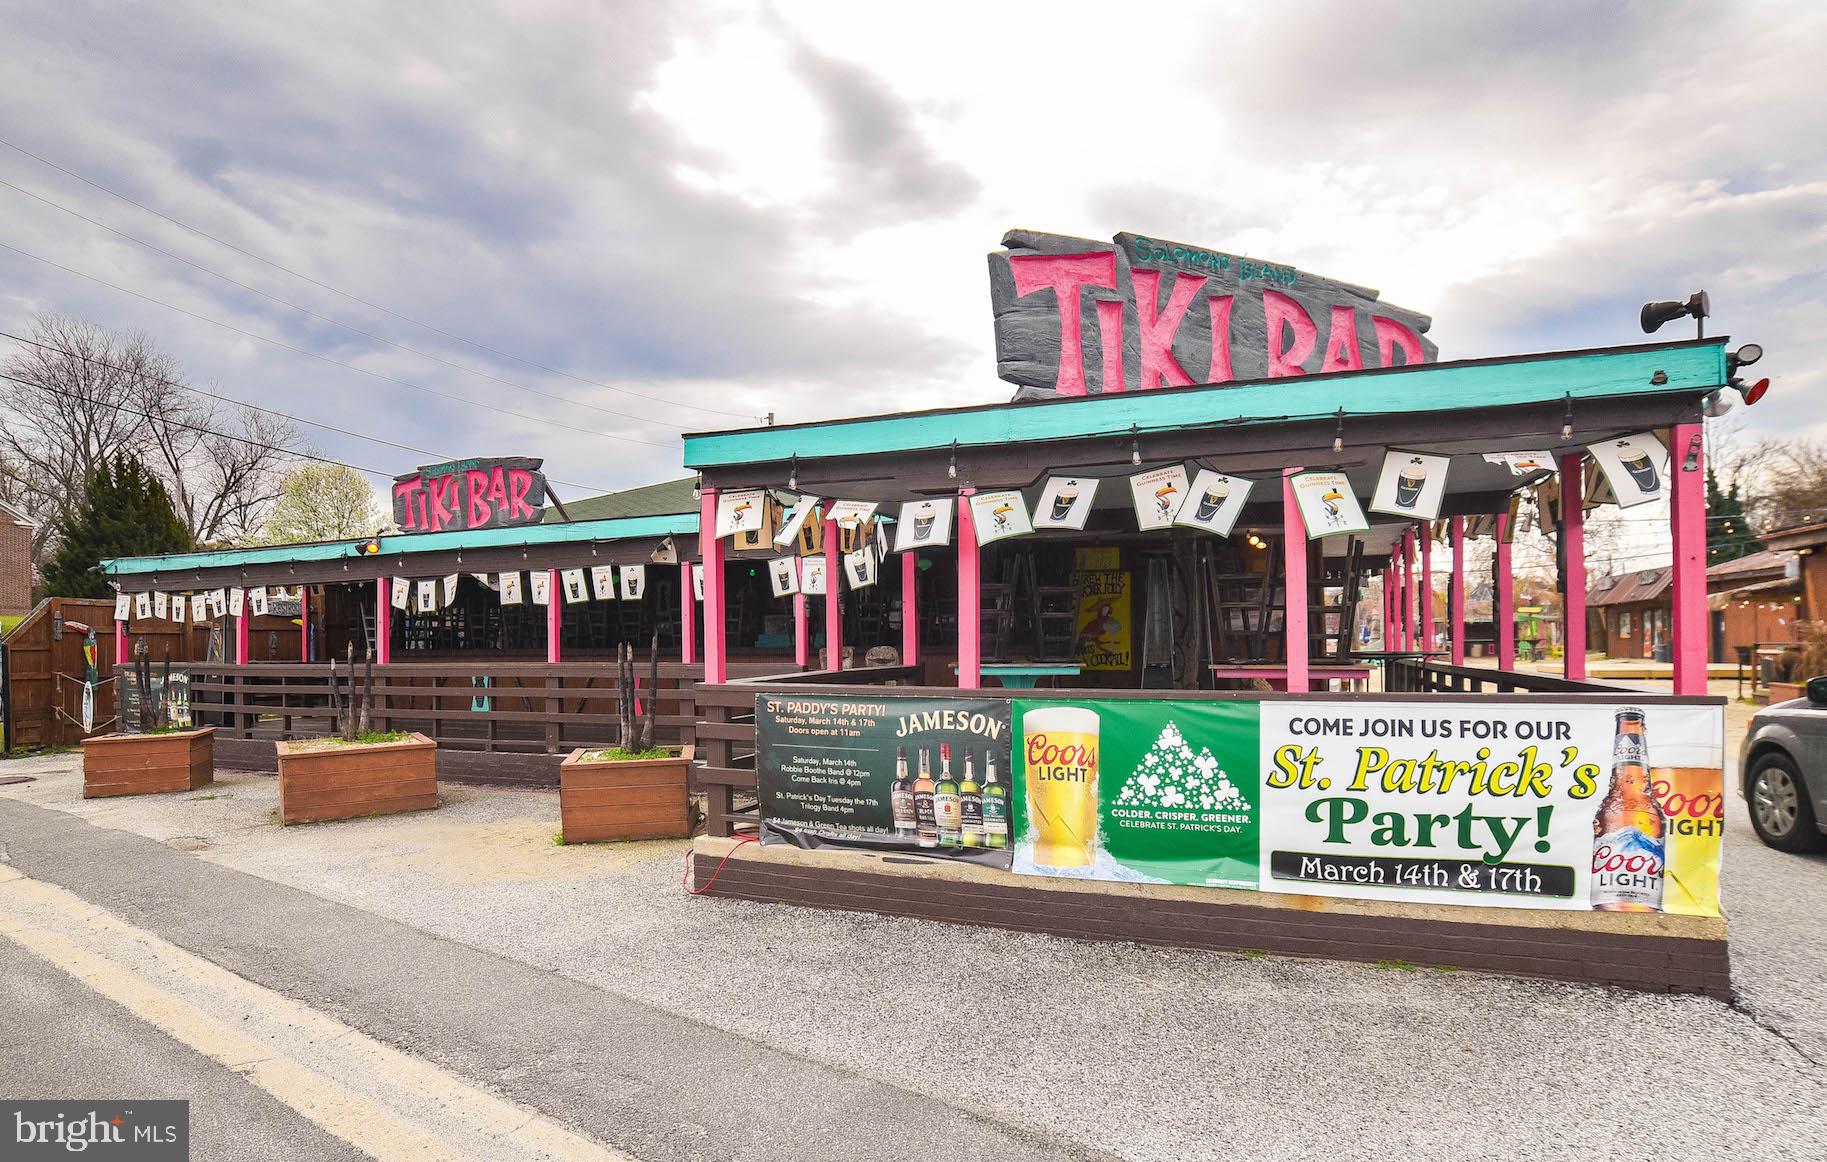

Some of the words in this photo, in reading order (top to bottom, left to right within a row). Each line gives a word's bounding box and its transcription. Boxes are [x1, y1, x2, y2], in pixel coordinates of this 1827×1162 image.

[466, 465, 535, 529] BAR
[160, 672, 188, 684] JMESON
[766, 701, 784, 713] ST.
[787, 702, 838, 715] PADDY'S
[842, 703, 886, 716] PARTY!
[776, 715, 808, 726] Saturday,
[809, 716, 830, 725] March
[832, 718, 849, 726] 14th
[850, 718, 856, 726] &
[858, 718, 876, 727] 17th
[896, 710, 1003, 740] JAMESON
[788, 726, 810, 734] Doors
[811, 728, 829, 737] open
[840, 728, 860, 736] 11am
[1289, 718, 1354, 736] COME
[1360, 718, 1414, 738] JOIN
[1421, 720, 1452, 738] US
[1460, 720, 1508, 740] FOR
[1515, 722, 1572, 740] OUR
[1027, 734, 1096, 768] Coors
[793, 756, 821, 766] Saturday,
[822, 758, 842, 766] March
[828, 767, 844, 776] Band
[845, 768, 853, 776] @
[853, 769, 870, 778] 12pm
[1038, 766, 1088, 783] LIGHT
[1266, 744, 1332, 790] St.
[1346, 746, 1601, 800] Patrick's
[792, 774, 810, 783] Come
[811, 776, 827, 784] Back
[846, 778, 861, 787] 4pm
[776, 792, 786, 800] St.
[786, 793, 814, 801] Patrick's
[814, 794, 827, 803] Day
[827, 795, 854, 806] Tuesday
[854, 797, 865, 805] the
[866, 798, 878, 806] 17th
[1651, 780, 1724, 818] Coor
[840, 806, 854, 814] 4pm
[1112, 809, 1153, 819] COLDER.
[1155, 811, 1199, 821] CRISPER.
[1202, 814, 1252, 824] GREENER.
[1120, 820, 1166, 830] CELEBRATE
[1180, 824, 1222, 832] PATRICK'S
[1304, 797, 1554, 866] Party!
[1669, 819, 1724, 836] IGHT
[1300, 856, 1385, 884] March
[1394, 863, 1448, 888] 14th
[1458, 864, 1480, 889] &
[1488, 870, 1542, 893] 17th
[1600, 874, 1658, 890] LIGHT
